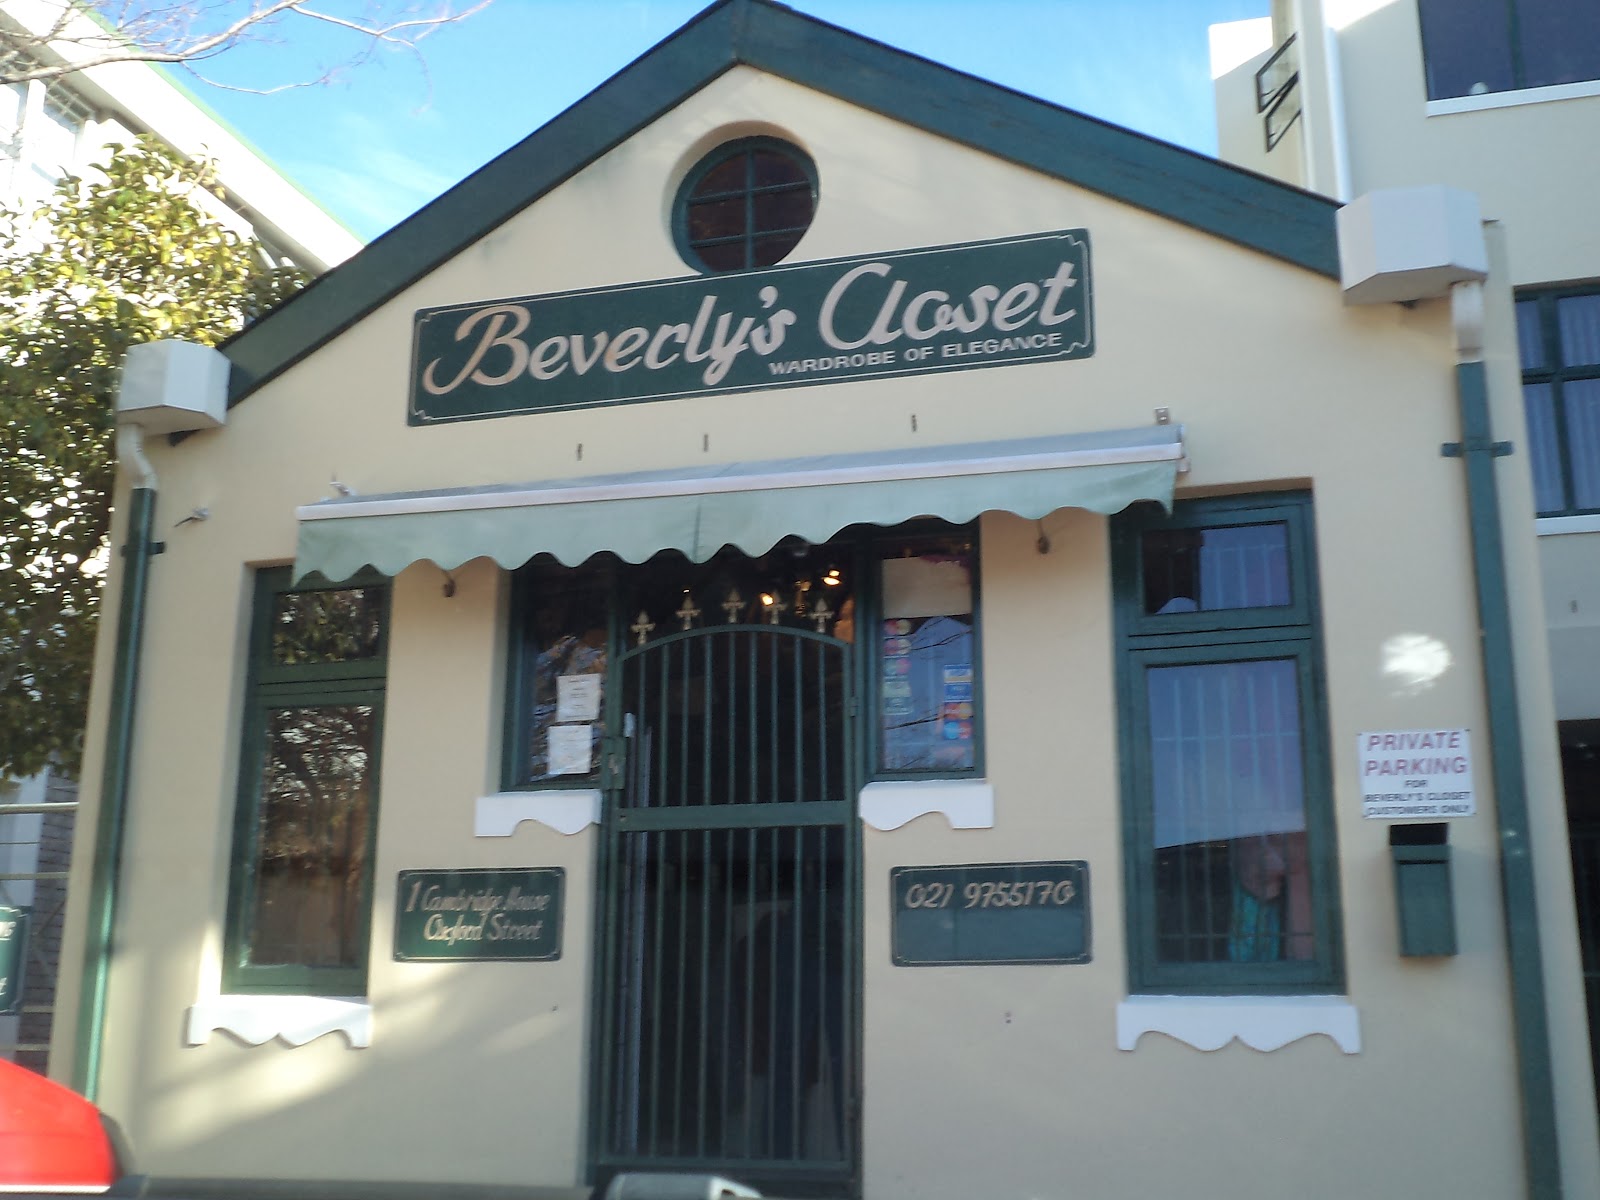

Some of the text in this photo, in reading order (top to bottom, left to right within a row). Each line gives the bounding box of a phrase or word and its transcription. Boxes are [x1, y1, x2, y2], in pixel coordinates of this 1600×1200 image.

[421, 261, 1078, 396] Beverly's Closet
[768, 332, 1063, 376] WARDROBE OF ELEGANCE
[1366, 731, 1461, 751] PRIVATE
[1364, 756, 1467, 776] PARKING
[1404, 779, 1428, 788] FOR
[1426, 790, 1471, 801] CLOSET
[1440, 804, 1470, 814] ONLY
[404, 881, 423, 912] 1
[905, 879, 1077, 909] 021 9755170
[423, 912, 544, 946] Oxford Street
